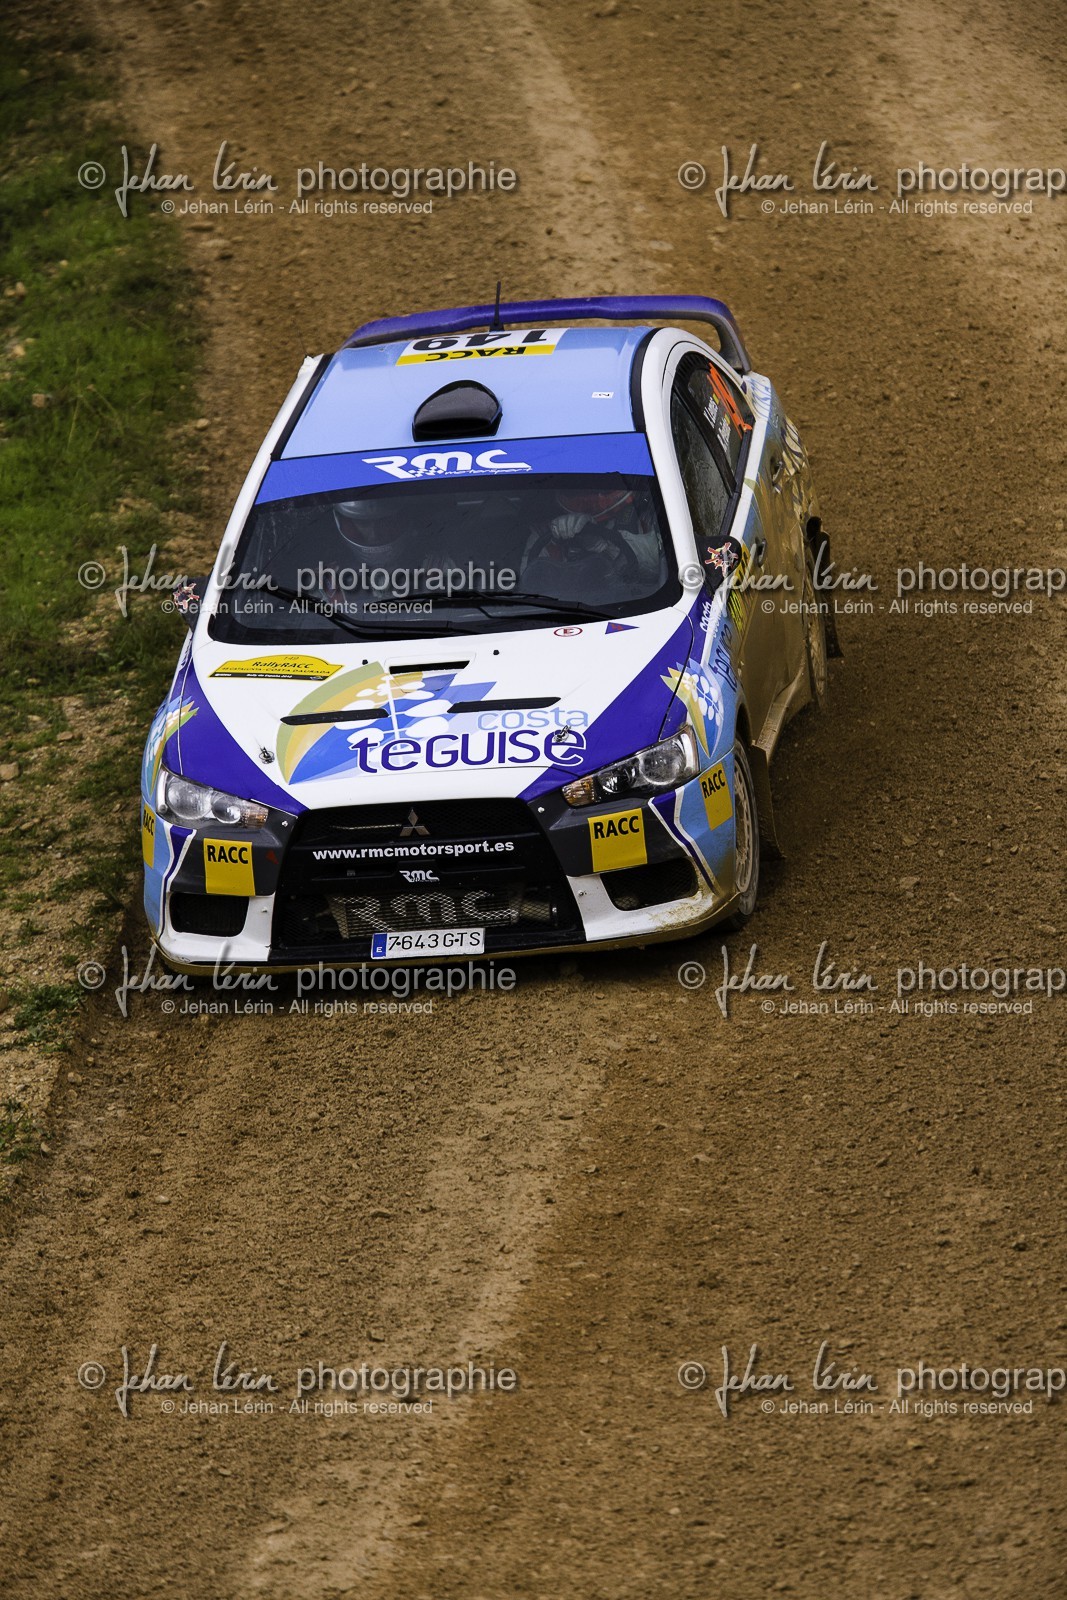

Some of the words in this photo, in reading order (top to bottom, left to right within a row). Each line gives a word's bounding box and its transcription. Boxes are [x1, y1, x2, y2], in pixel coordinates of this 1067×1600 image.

[412, 329, 547, 351] 149
[425, 346, 527, 362] RACC
[252, 661, 314, 669] RallyRACC
[477, 706, 589, 731] costa
[701, 769, 727, 799] RACC
[593, 815, 641, 840] RACC
[206, 844, 249, 865] RACC
[312, 840, 515, 861] www.rmcmotorsport.es
[388, 933, 438, 951] 7643
[443, 932, 481, 948] GTS
